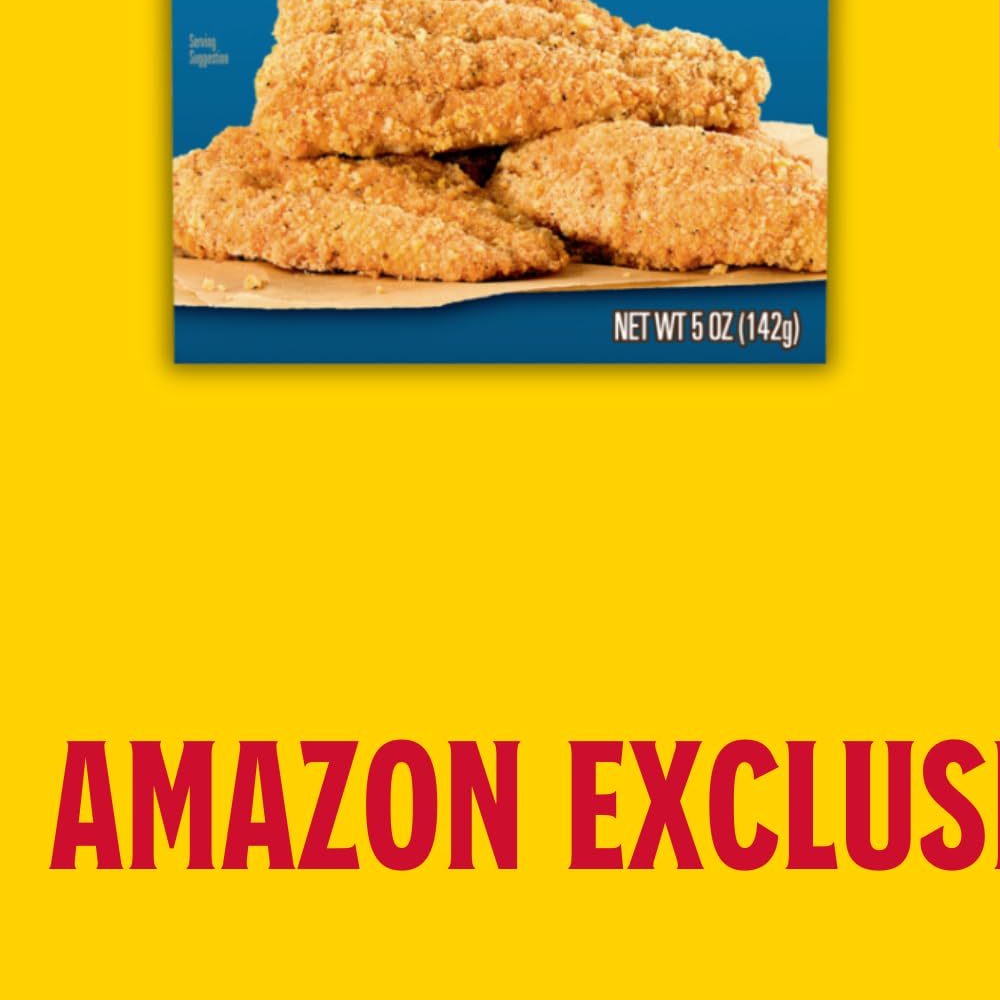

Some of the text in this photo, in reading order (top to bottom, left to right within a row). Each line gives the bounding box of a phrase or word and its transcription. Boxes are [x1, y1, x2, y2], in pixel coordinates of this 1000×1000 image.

[614, 311, 800, 348] NET WT 5 OZ (142g)
